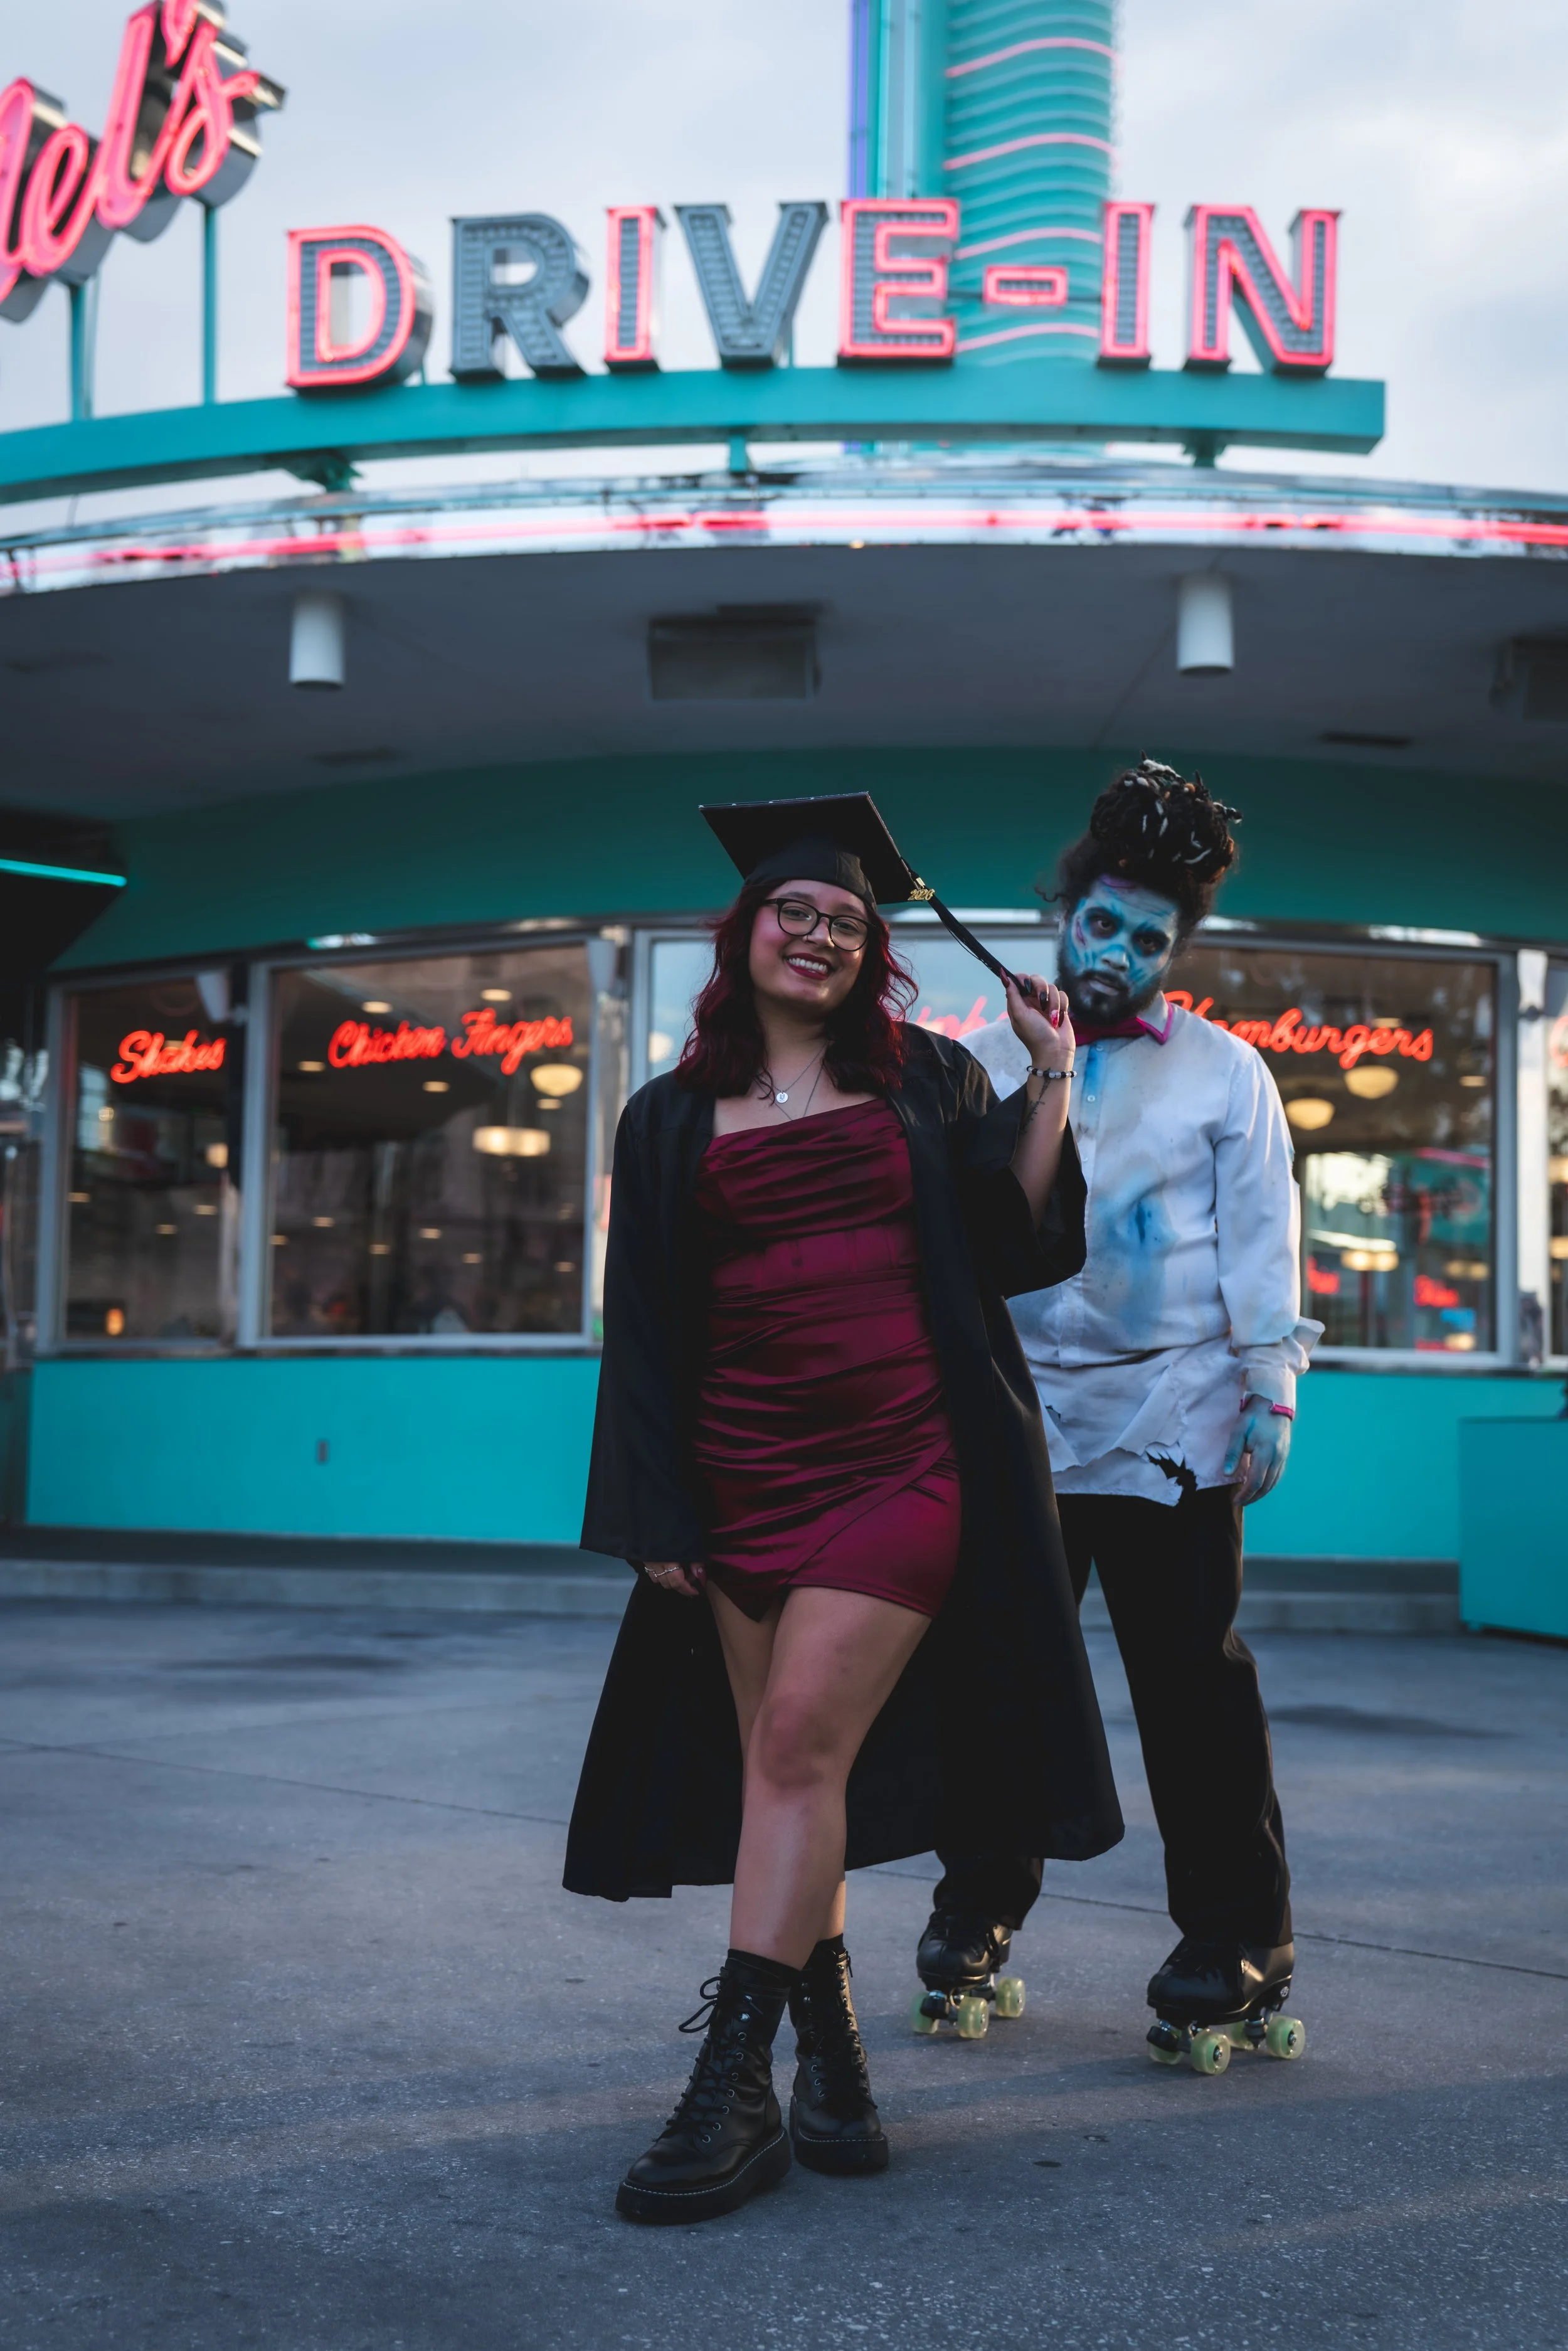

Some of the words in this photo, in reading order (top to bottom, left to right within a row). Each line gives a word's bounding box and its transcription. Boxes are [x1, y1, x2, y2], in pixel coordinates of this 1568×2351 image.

[286, 198, 1342, 390] DRIVE-IN
[327, 1019, 447, 1069] Chicken
[450, 1007, 573, 1076] Fingers
[1164, 990, 1434, 1070] mburgers
